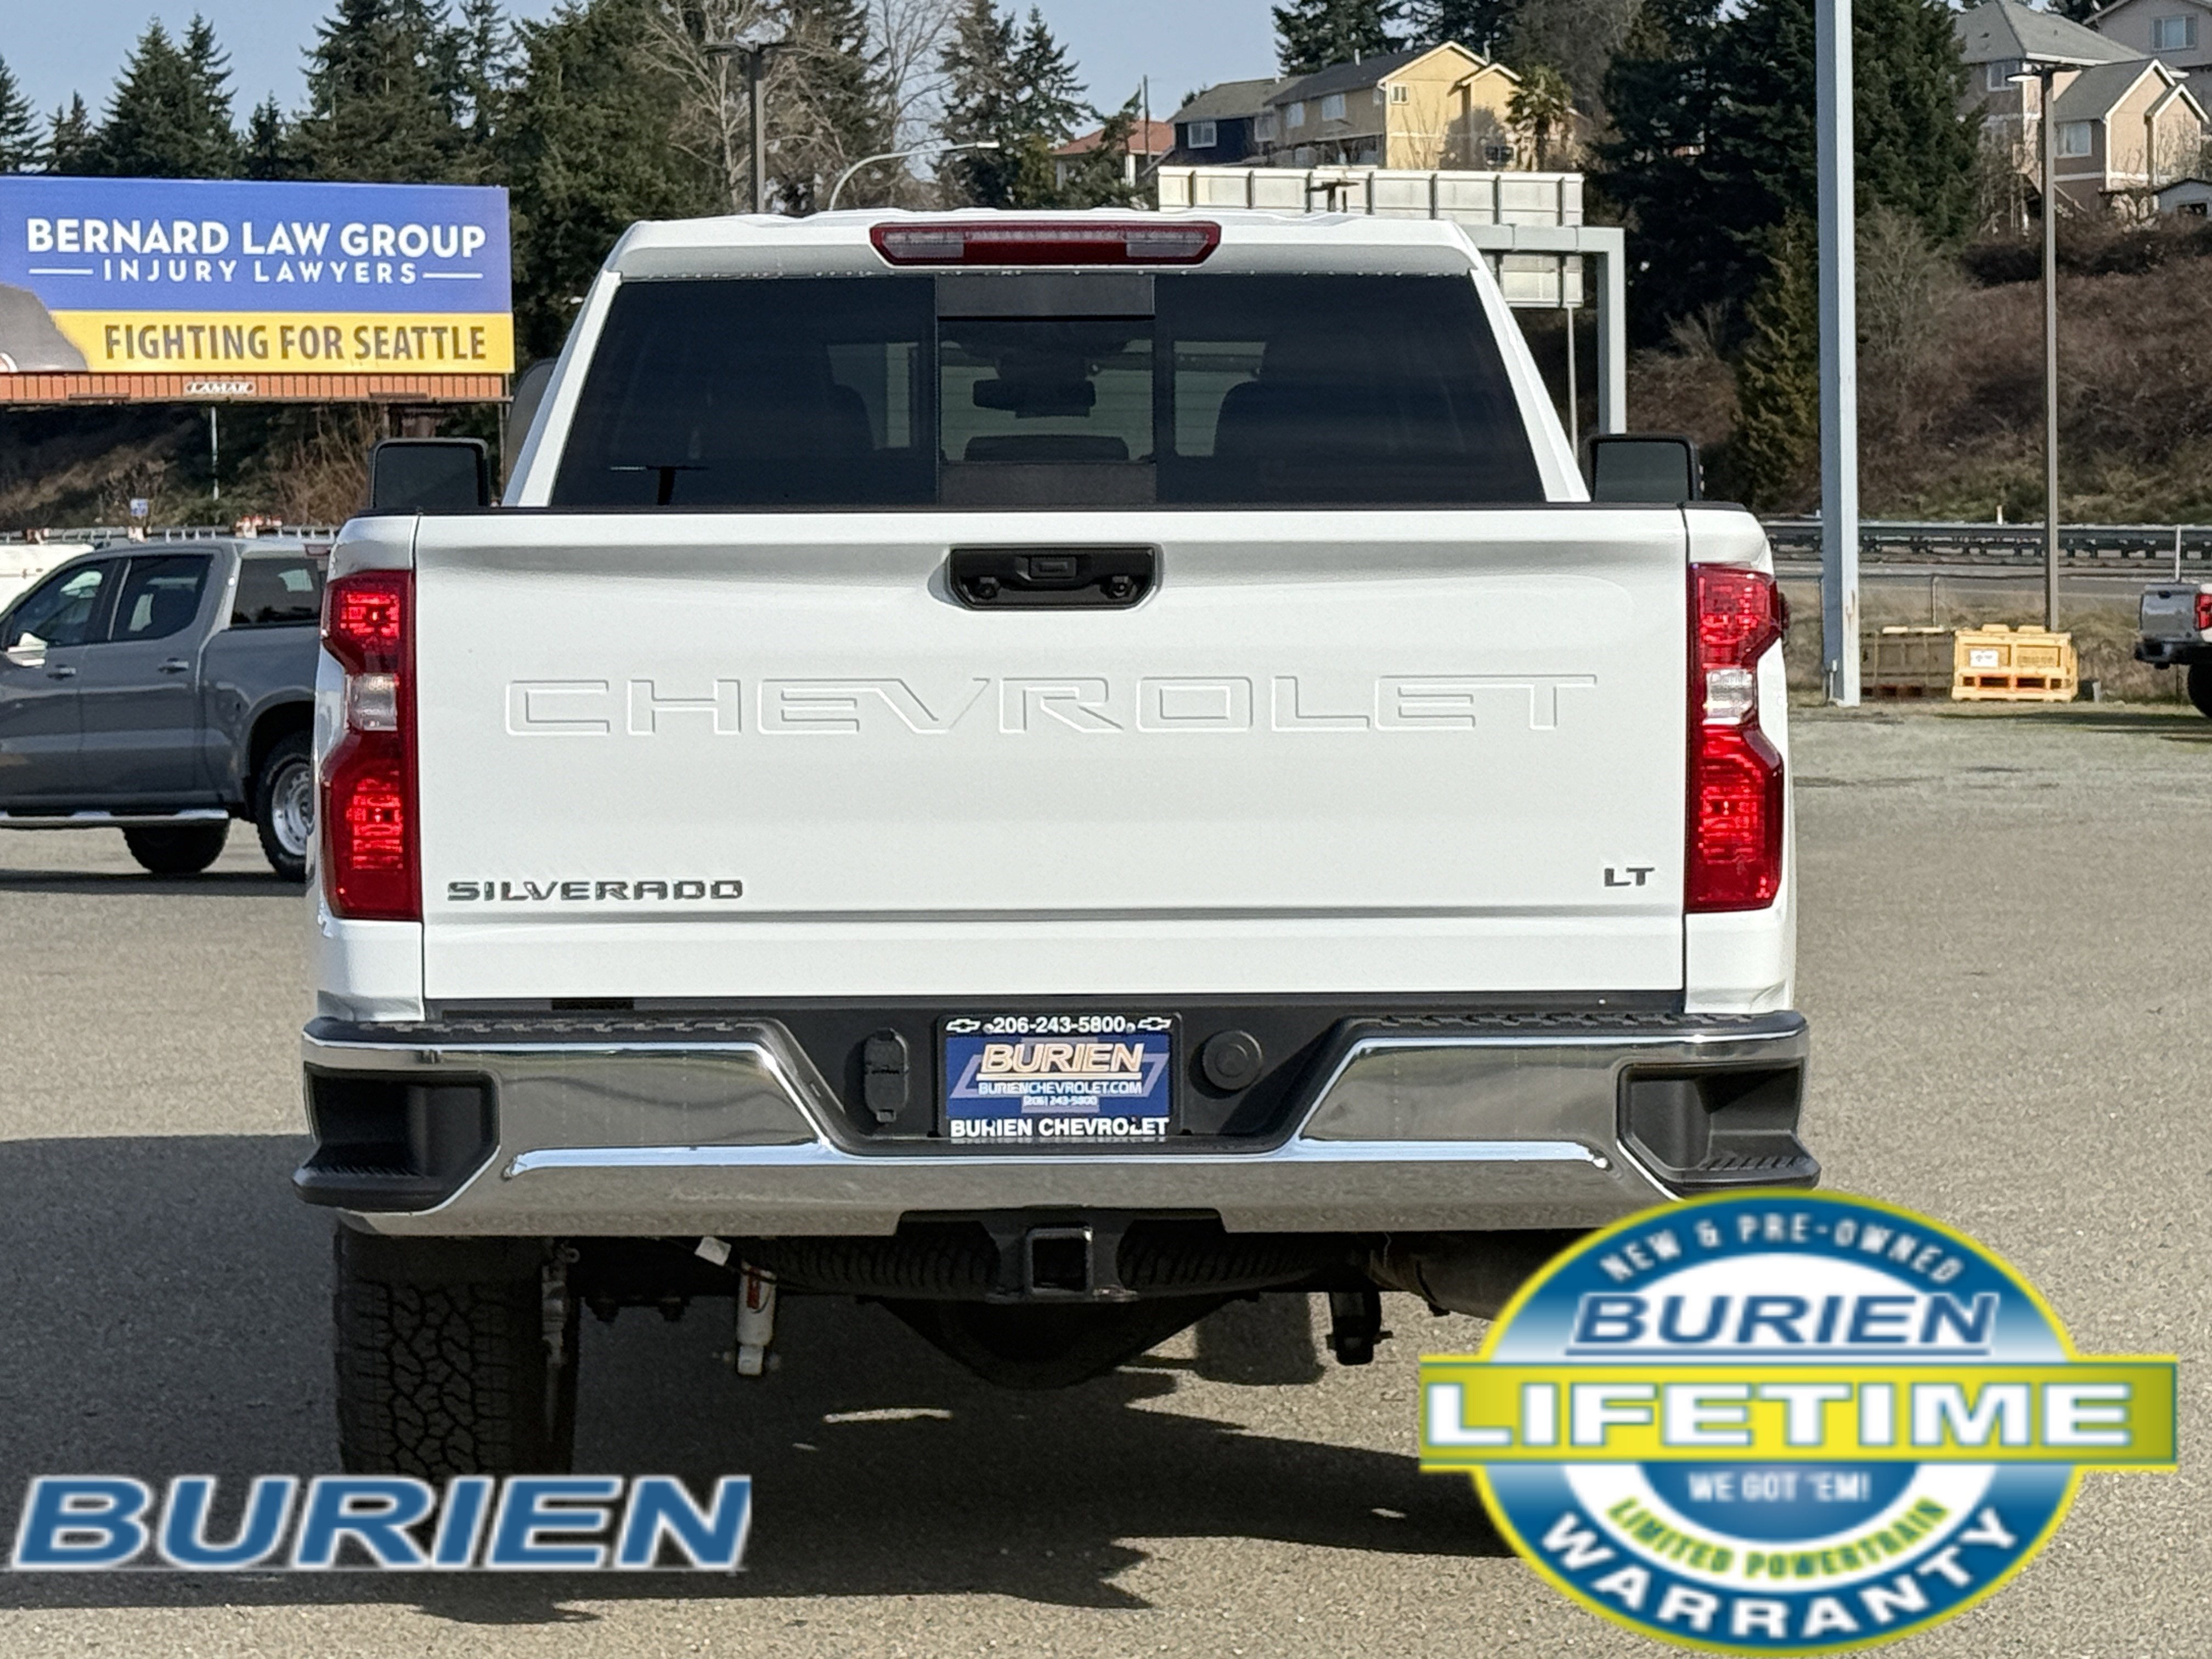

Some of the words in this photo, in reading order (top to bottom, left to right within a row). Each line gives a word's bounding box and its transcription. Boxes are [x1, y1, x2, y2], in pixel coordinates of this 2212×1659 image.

[26, 218, 229, 255] BERNARD
[242, 222, 331, 256] LAW
[340, 223, 487, 258] GROUP
[104, 259, 238, 283] INJURY
[254, 261, 417, 284] LAWYERS
[105, 324, 269, 360] FIGHTING
[280, 325, 345, 360] FOR
[354, 326, 487, 361] SEATTLE
[187, 381, 253, 394] LAMAR
[505, 675, 1597, 736] CHEVROLET
[1604, 867, 1655, 887] LT
[447, 879, 743, 901] SILVERADO
[992, 1016, 1126, 1033] 206-243-5800
[981, 1043, 1145, 1073] BURIEN
[978, 1081, 1142, 1095] BURIENCHEVROLET.COM
[950, 1119, 1032, 1137] BURIEN
[1038, 1118, 1170, 1137] CHEVROLET
